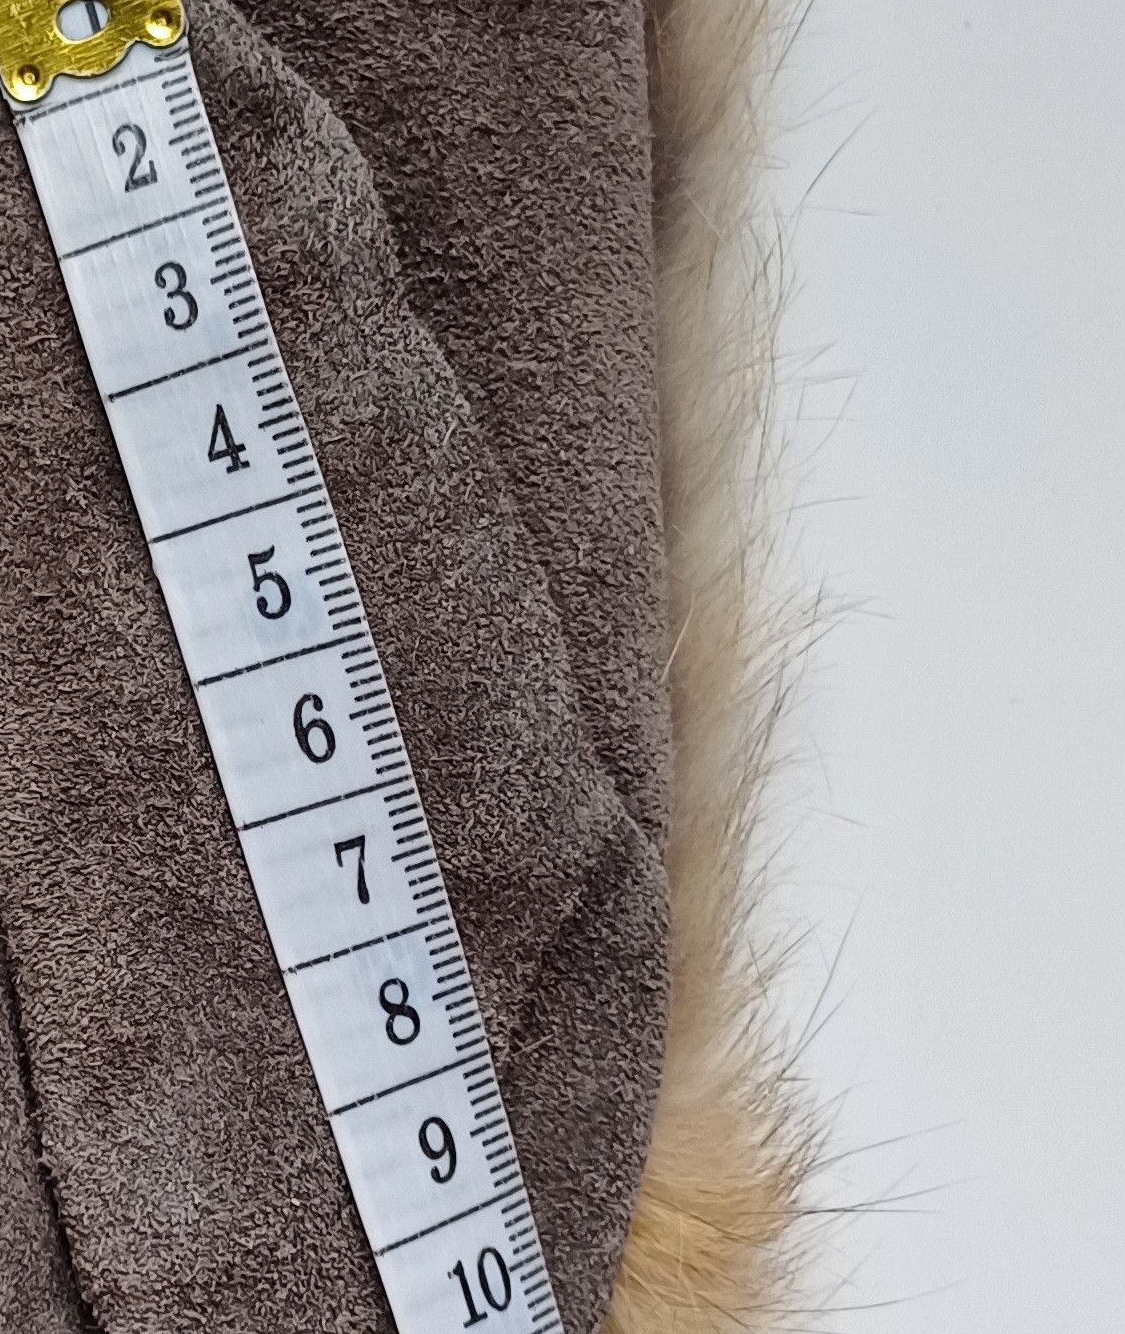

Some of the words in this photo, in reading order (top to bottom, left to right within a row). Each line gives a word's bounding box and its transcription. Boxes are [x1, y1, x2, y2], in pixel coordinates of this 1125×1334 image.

[112, 124, 158, 193] 2
[155, 261, 198, 331] 3
[208, 404, 250, 474] 4
[248, 545, 291, 620] 5
[293, 693, 336, 764] 6
[334, 835, 370, 904] 7
[378, 978, 420, 1046] 8
[418, 1116, 457, 1184] 9
[448, 1247, 511, 1328] 10
